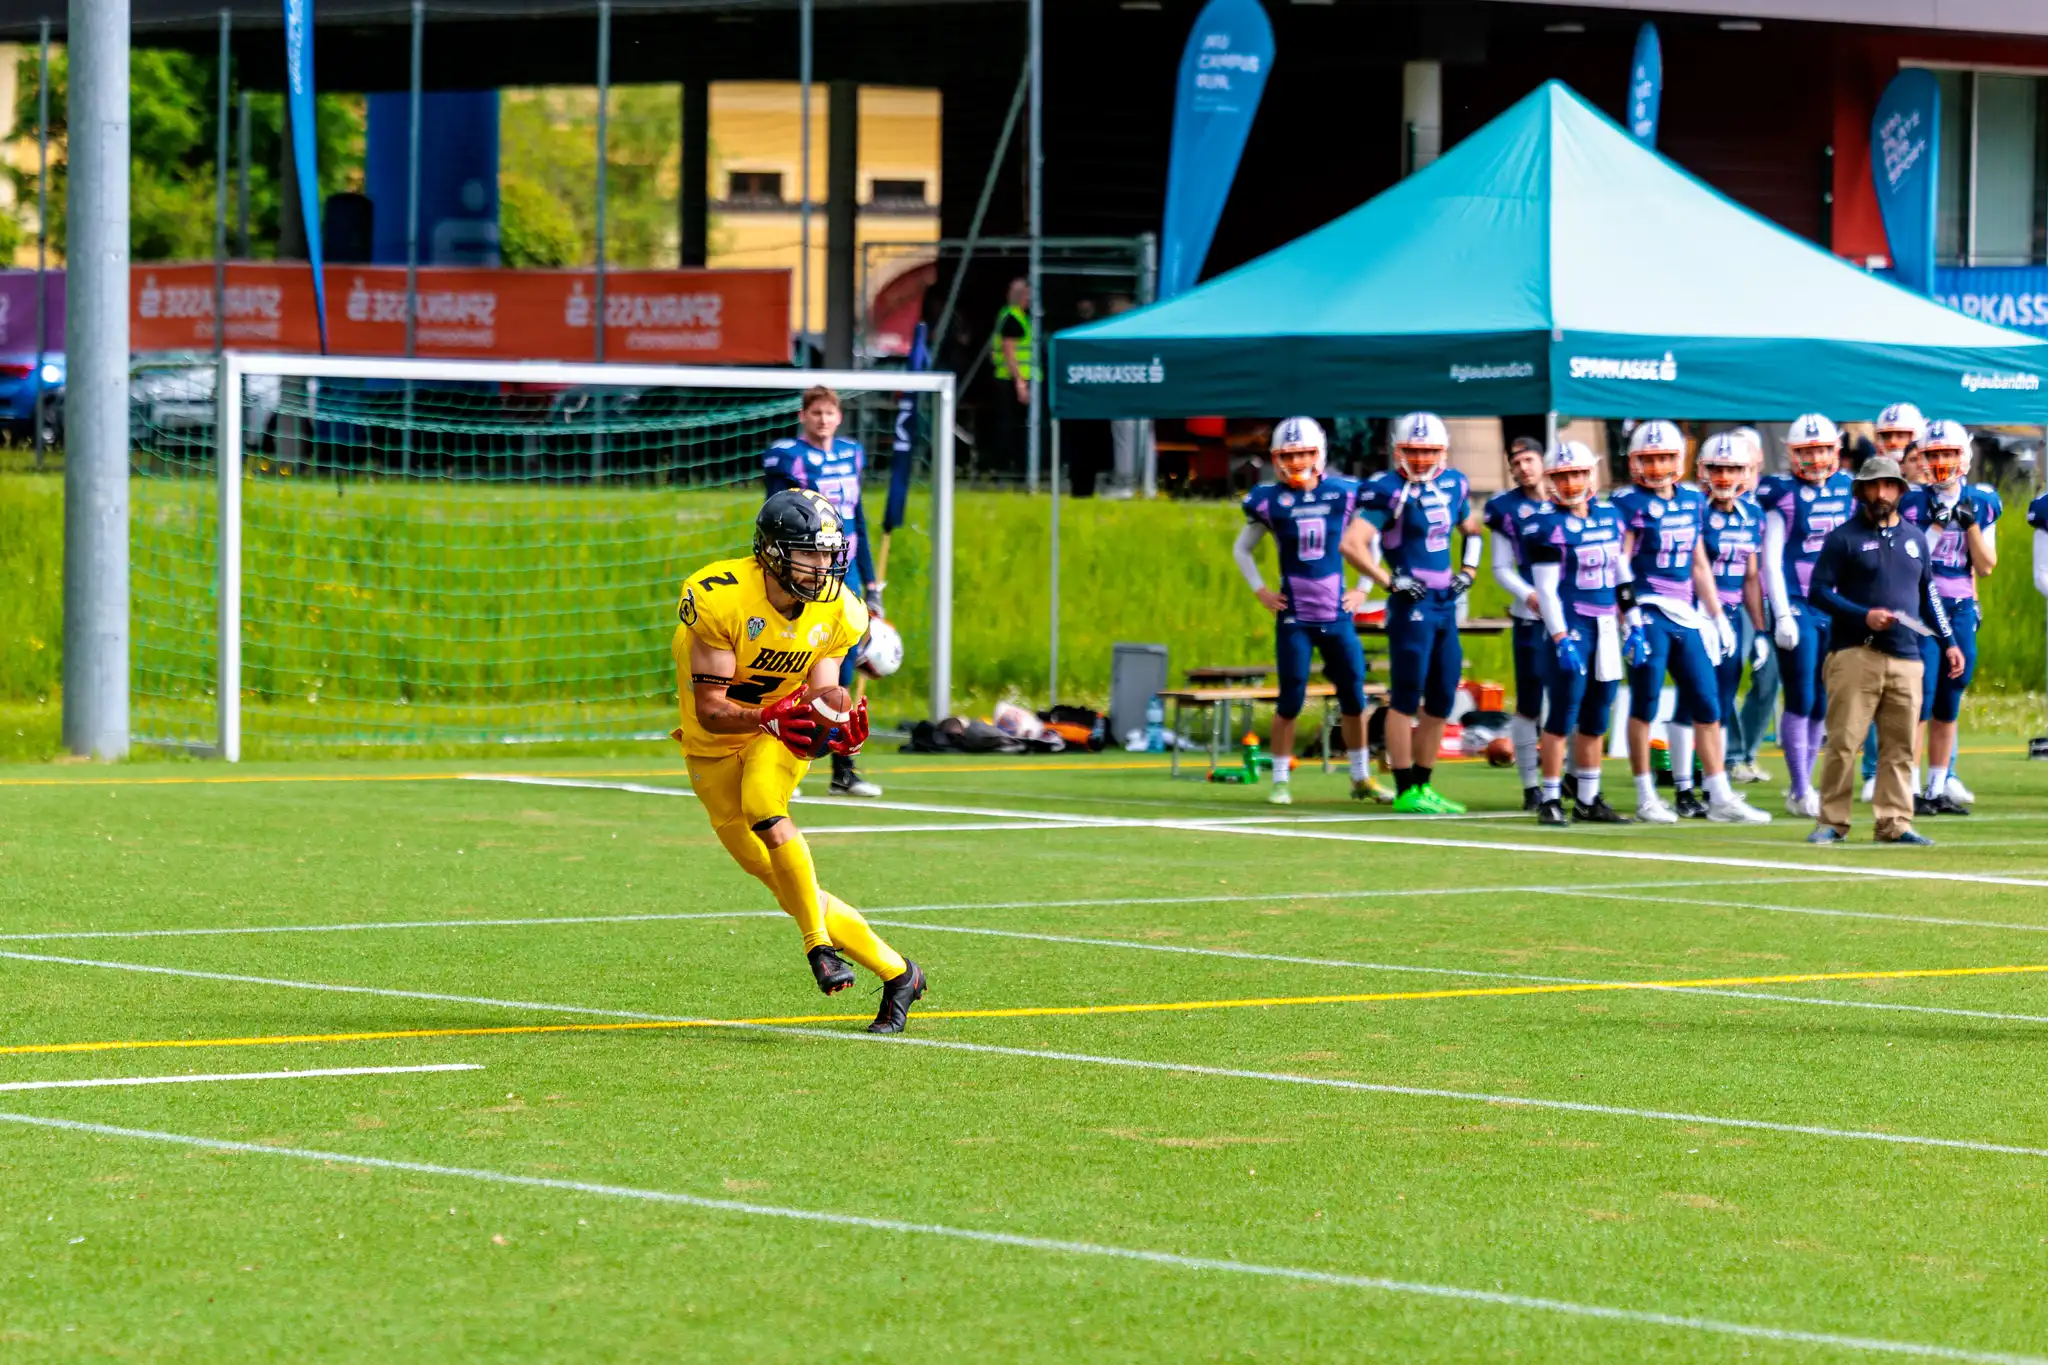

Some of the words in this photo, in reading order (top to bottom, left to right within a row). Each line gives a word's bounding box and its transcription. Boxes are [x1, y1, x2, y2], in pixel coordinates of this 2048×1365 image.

[1569, 356, 1659, 380] SPARKASSE
[1961, 372, 2040, 392] #glaubandich
[1297, 517, 1326, 561] 0
[1425, 506, 1451, 552] 2
[1656, 528, 1697, 569] 17
[1802, 513, 1847, 553] 2
[746, 647, 812, 673] BOKU
